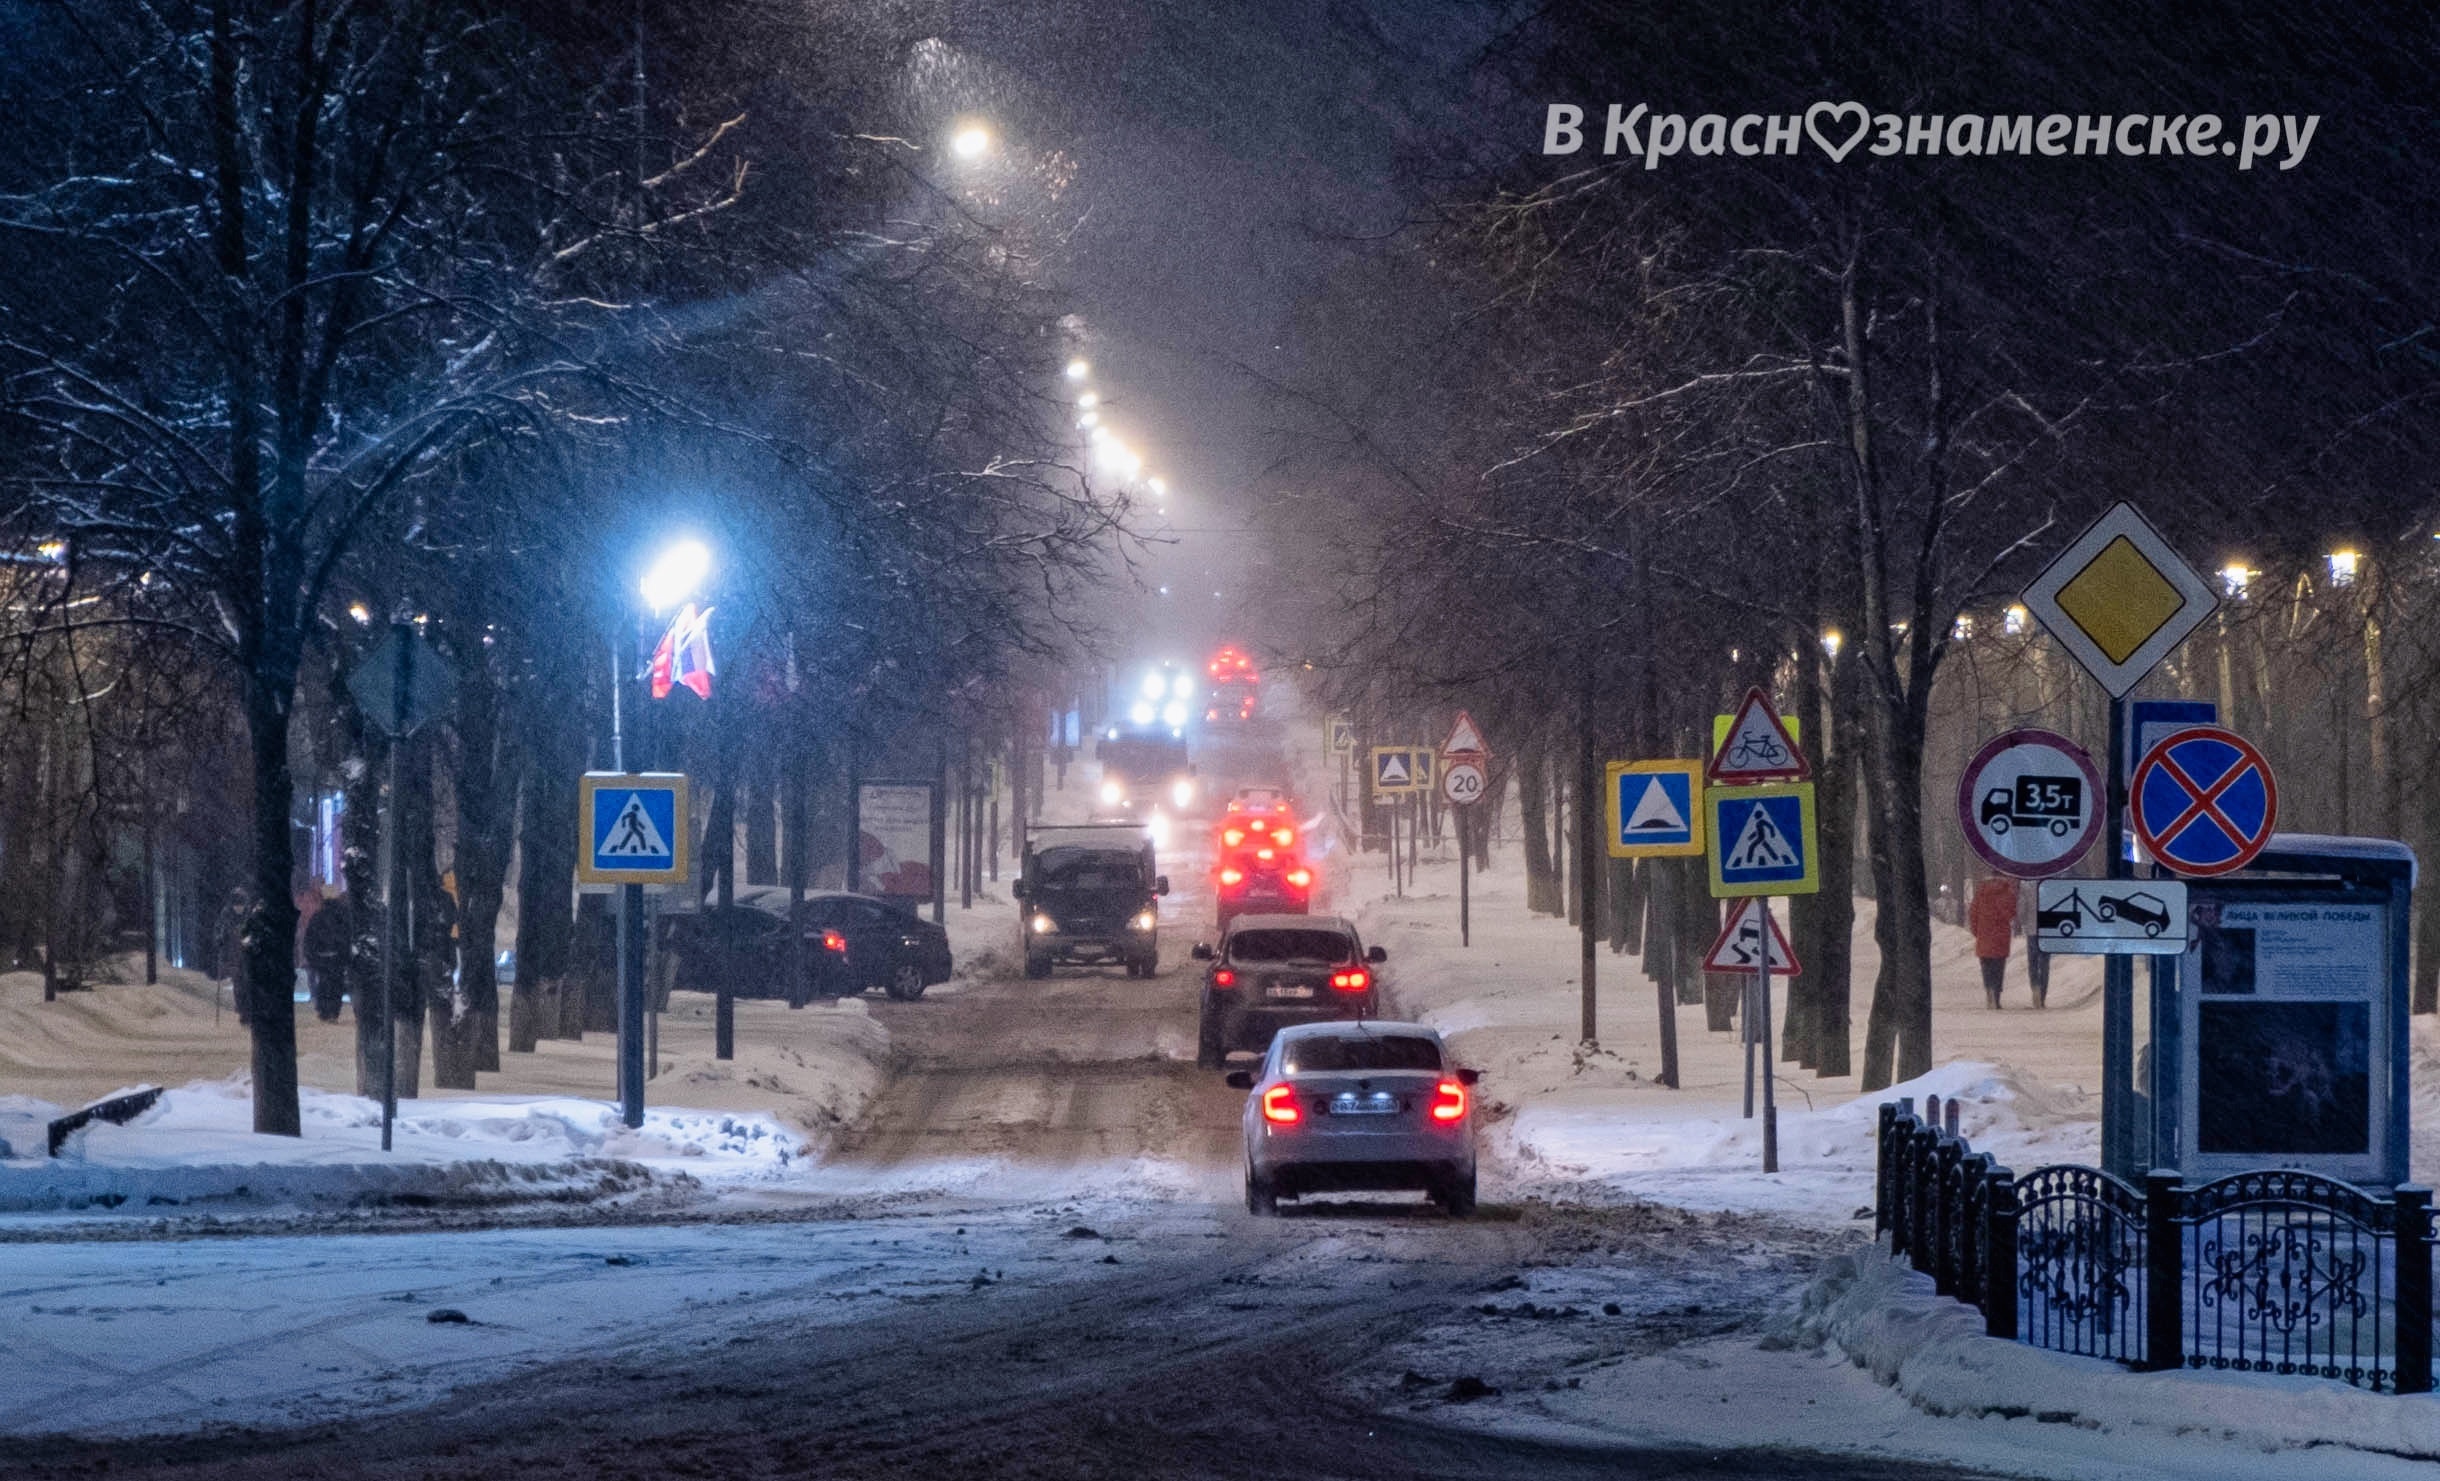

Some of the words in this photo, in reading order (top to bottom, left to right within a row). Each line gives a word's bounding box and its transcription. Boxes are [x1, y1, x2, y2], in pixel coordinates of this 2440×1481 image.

[1453, 775, 1478, 793] 20
[2025, 783, 2074, 811] 3,5т
[2323, 911, 2371, 922] ПОБЕДЫ
